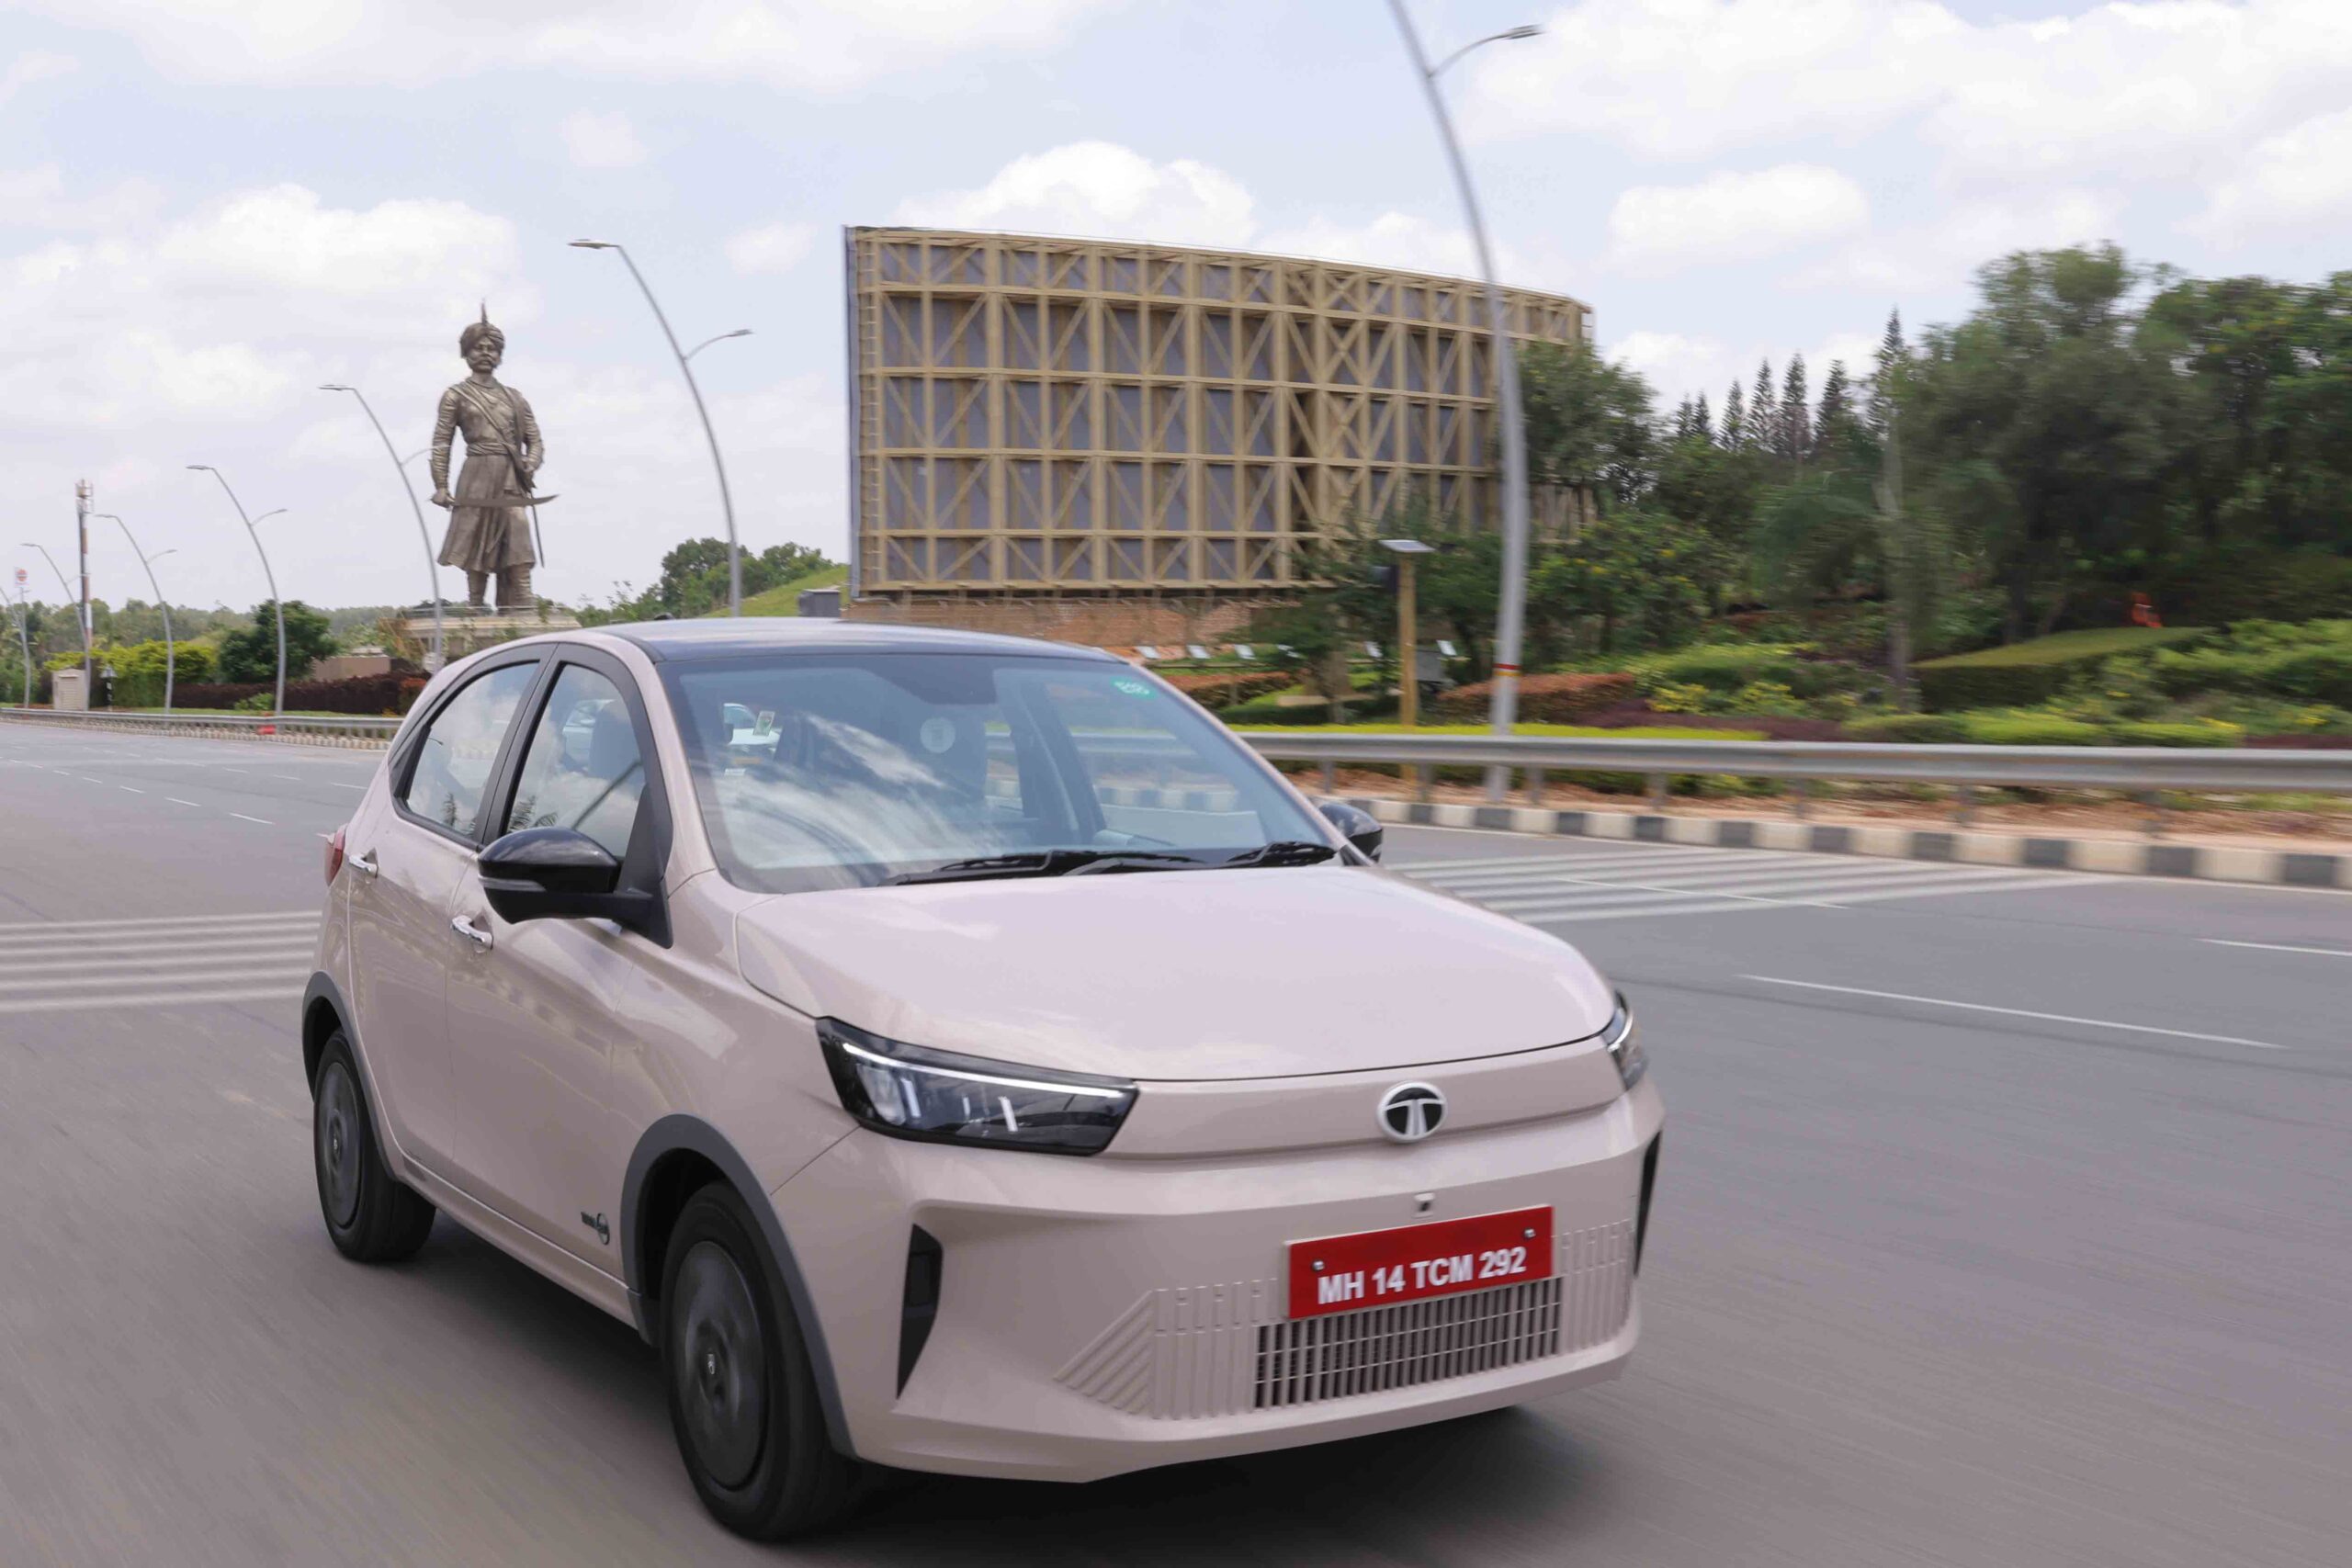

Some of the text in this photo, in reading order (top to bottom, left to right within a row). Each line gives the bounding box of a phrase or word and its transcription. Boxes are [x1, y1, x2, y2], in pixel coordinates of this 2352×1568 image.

[1317, 1246, 1527, 1304] MH 14 TCM 292
